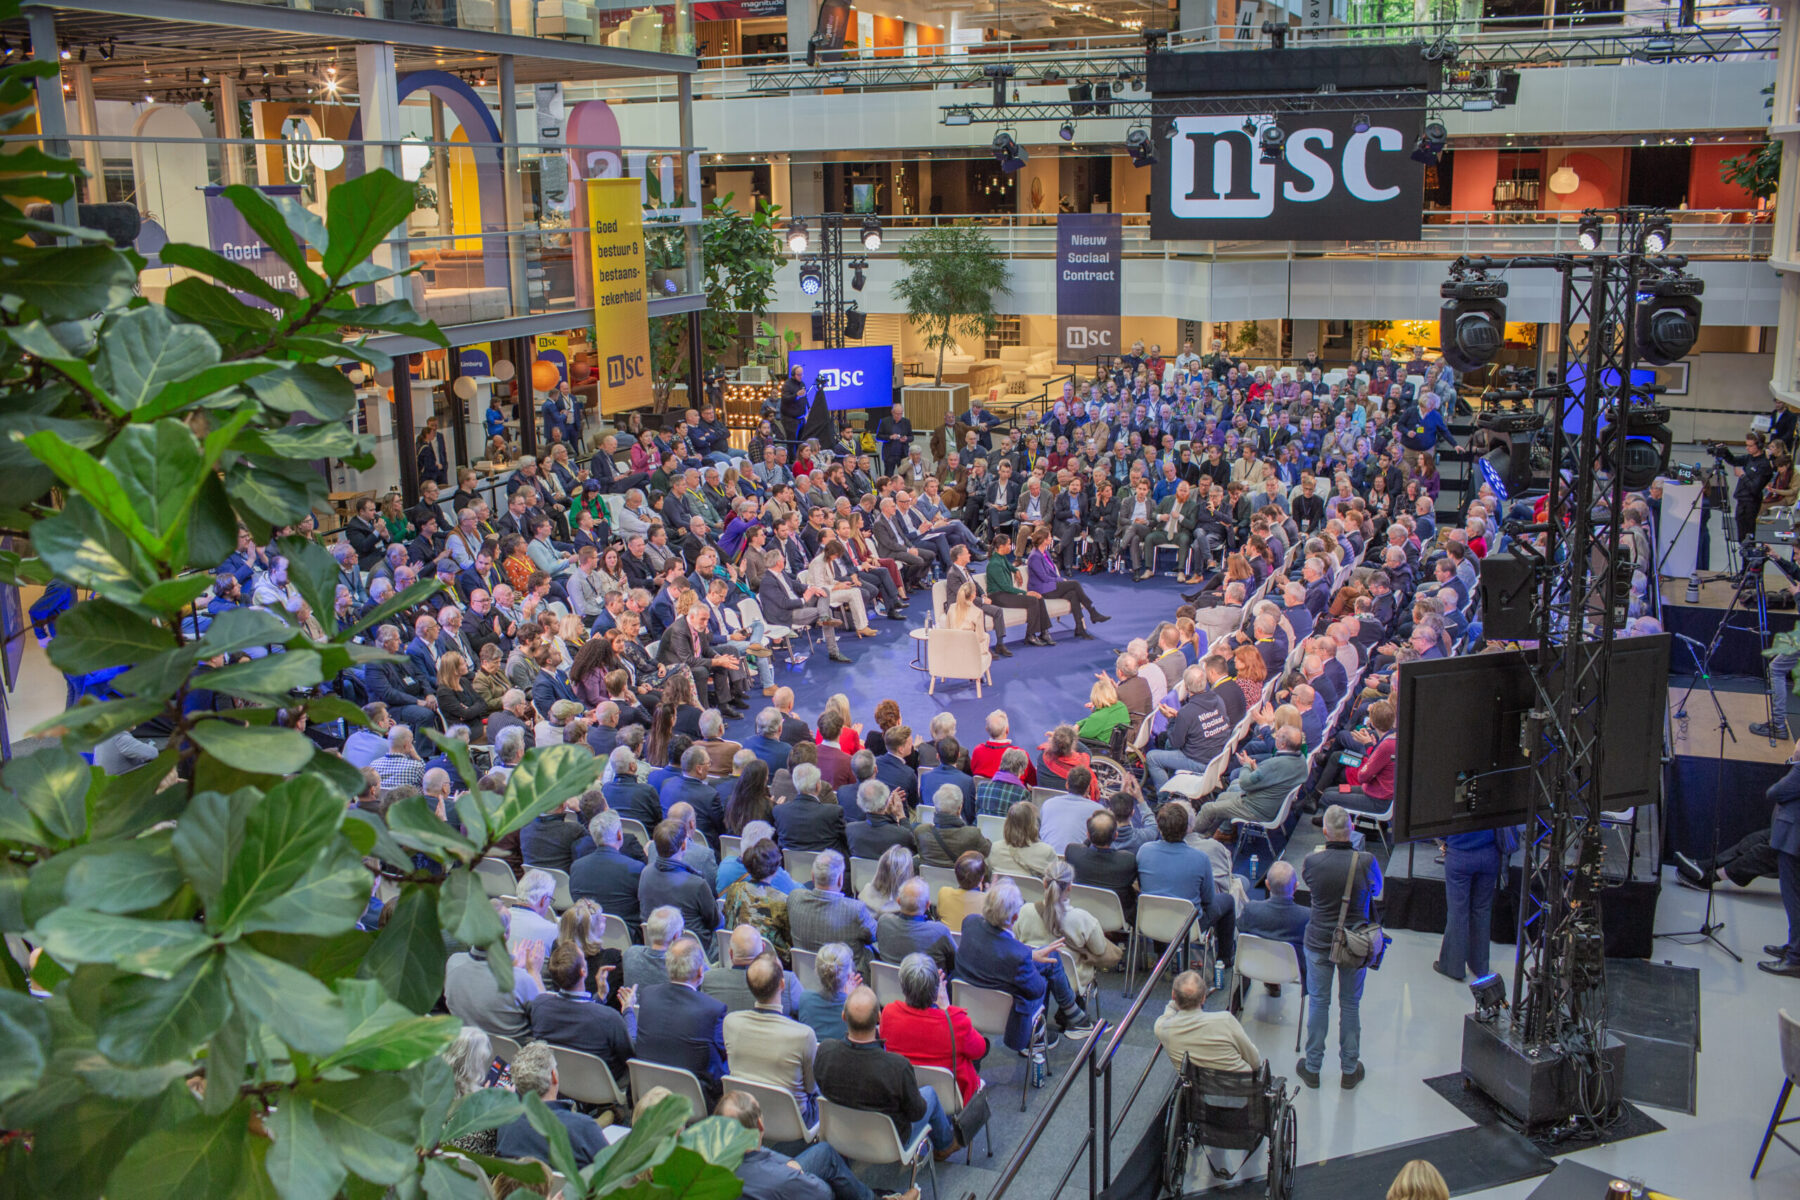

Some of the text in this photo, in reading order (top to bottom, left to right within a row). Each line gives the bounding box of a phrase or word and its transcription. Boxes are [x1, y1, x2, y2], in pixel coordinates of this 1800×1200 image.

[1171, 115, 1403, 218] nsc
[596, 219, 617, 233] Goed
[1071, 235, 1107, 246] Nieuw
[223, 241, 261, 260] Goed
[598, 242, 638, 258] bestuur &
[1068, 252, 1110, 263] Sociaal
[600, 268, 640, 282] bestaans-
[1063, 270, 1115, 281] Contract
[601, 288, 642, 306] zekerheid
[539, 337, 557, 347] nsc
[1066, 327, 1112, 349] nsc
[607, 354, 644, 388] nsc
[819, 368, 864, 392] nsc
